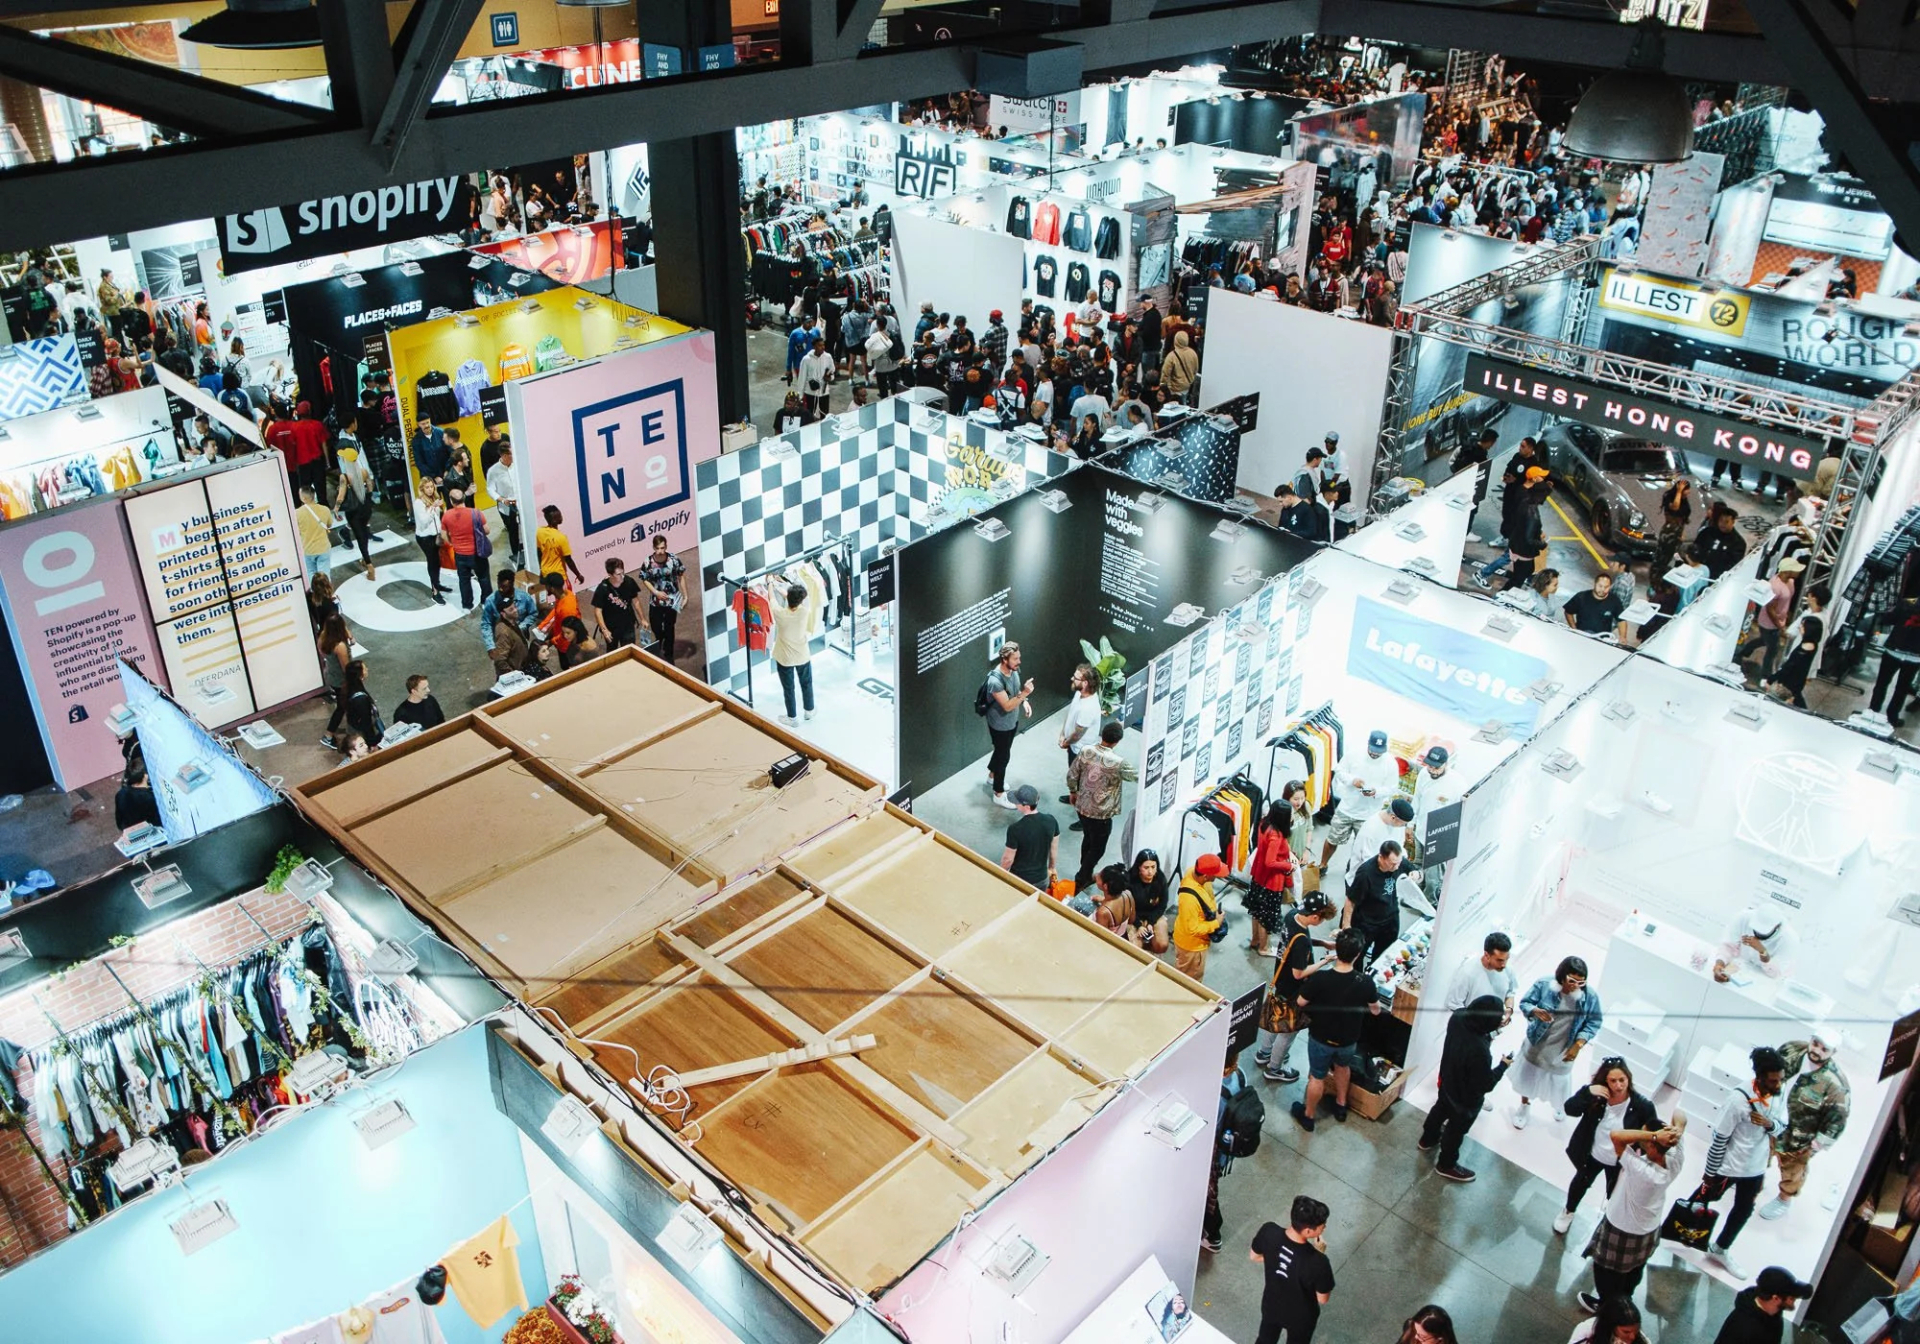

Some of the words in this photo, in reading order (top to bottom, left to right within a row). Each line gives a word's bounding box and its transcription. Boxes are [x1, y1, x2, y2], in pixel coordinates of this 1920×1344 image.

[1002, 106, 1034, 119] SWISS
[1039, 112, 1067, 124] MADE
[1611, 279, 1699, 316] ILLEST
[344, 300, 423, 329] PLACES+FACES
[1713, 304, 1736, 322] 72
[77, 336, 93, 344] DAILY
[365, 341, 383, 349] PLACES
[1784, 341, 1917, 367] WORLD
[400, 396, 411, 418] DUAL
[483, 411, 495, 419] J11
[1428, 404, 1445, 424] BUT
[1483, 370, 1589, 410] ILLEST
[1605, 401, 1695, 439] HONG
[1713, 429, 1812, 470] KONG
[944, 466, 993, 491] WOR
[1106, 488, 1135, 509] Made
[1105, 502, 1128, 520] with
[233, 514, 264, 533] after
[584, 538, 616, 558] powered
[617, 536, 627, 548] by
[647, 510, 690, 536] shopify
[158, 545, 209, 571] printed
[237, 532, 256, 545] art
[258, 526, 275, 537] on
[161, 560, 213, 584] t-shirts
[236, 543, 267, 564] gifts
[869, 564, 890, 577] GARAGE
[165, 584, 186, 599] for
[187, 570, 240, 593] friends
[241, 558, 266, 576] and
[869, 574, 883, 584] WELT
[169, 597, 203, 614] soon
[204, 583, 244, 603] other
[245, 566, 290, 591] people
[173, 612, 207, 630] were
[208, 588, 280, 617] interested
[282, 583, 294, 594] in
[43, 624, 64, 638] TEN
[65, 610, 107, 634] powered
[107, 607, 120, 621] by
[46, 629, 85, 649] Shopify
[85, 626, 94, 638] is
[102, 613, 137, 634] pop-up
[50, 634, 107, 659] showcasing
[107, 628, 124, 641] the
[176, 627, 217, 645] them.
[53, 647, 100, 669] creativity
[100, 641, 110, 653] of
[56, 657, 104, 679] influential
[58, 676, 80, 689] who
[81, 671, 97, 682] are
[97, 653, 146, 677] disruing
[1365, 627, 1528, 706] Lafayette
[62, 687, 79, 699] the
[79, 679, 105, 693] retail
[1427, 820, 1460, 837] LAFAYETTE
[1425, 845, 1437, 856] J5
[1230, 1009, 1254, 1028] EHSANI
[1231, 997, 1260, 1020] MELODY
